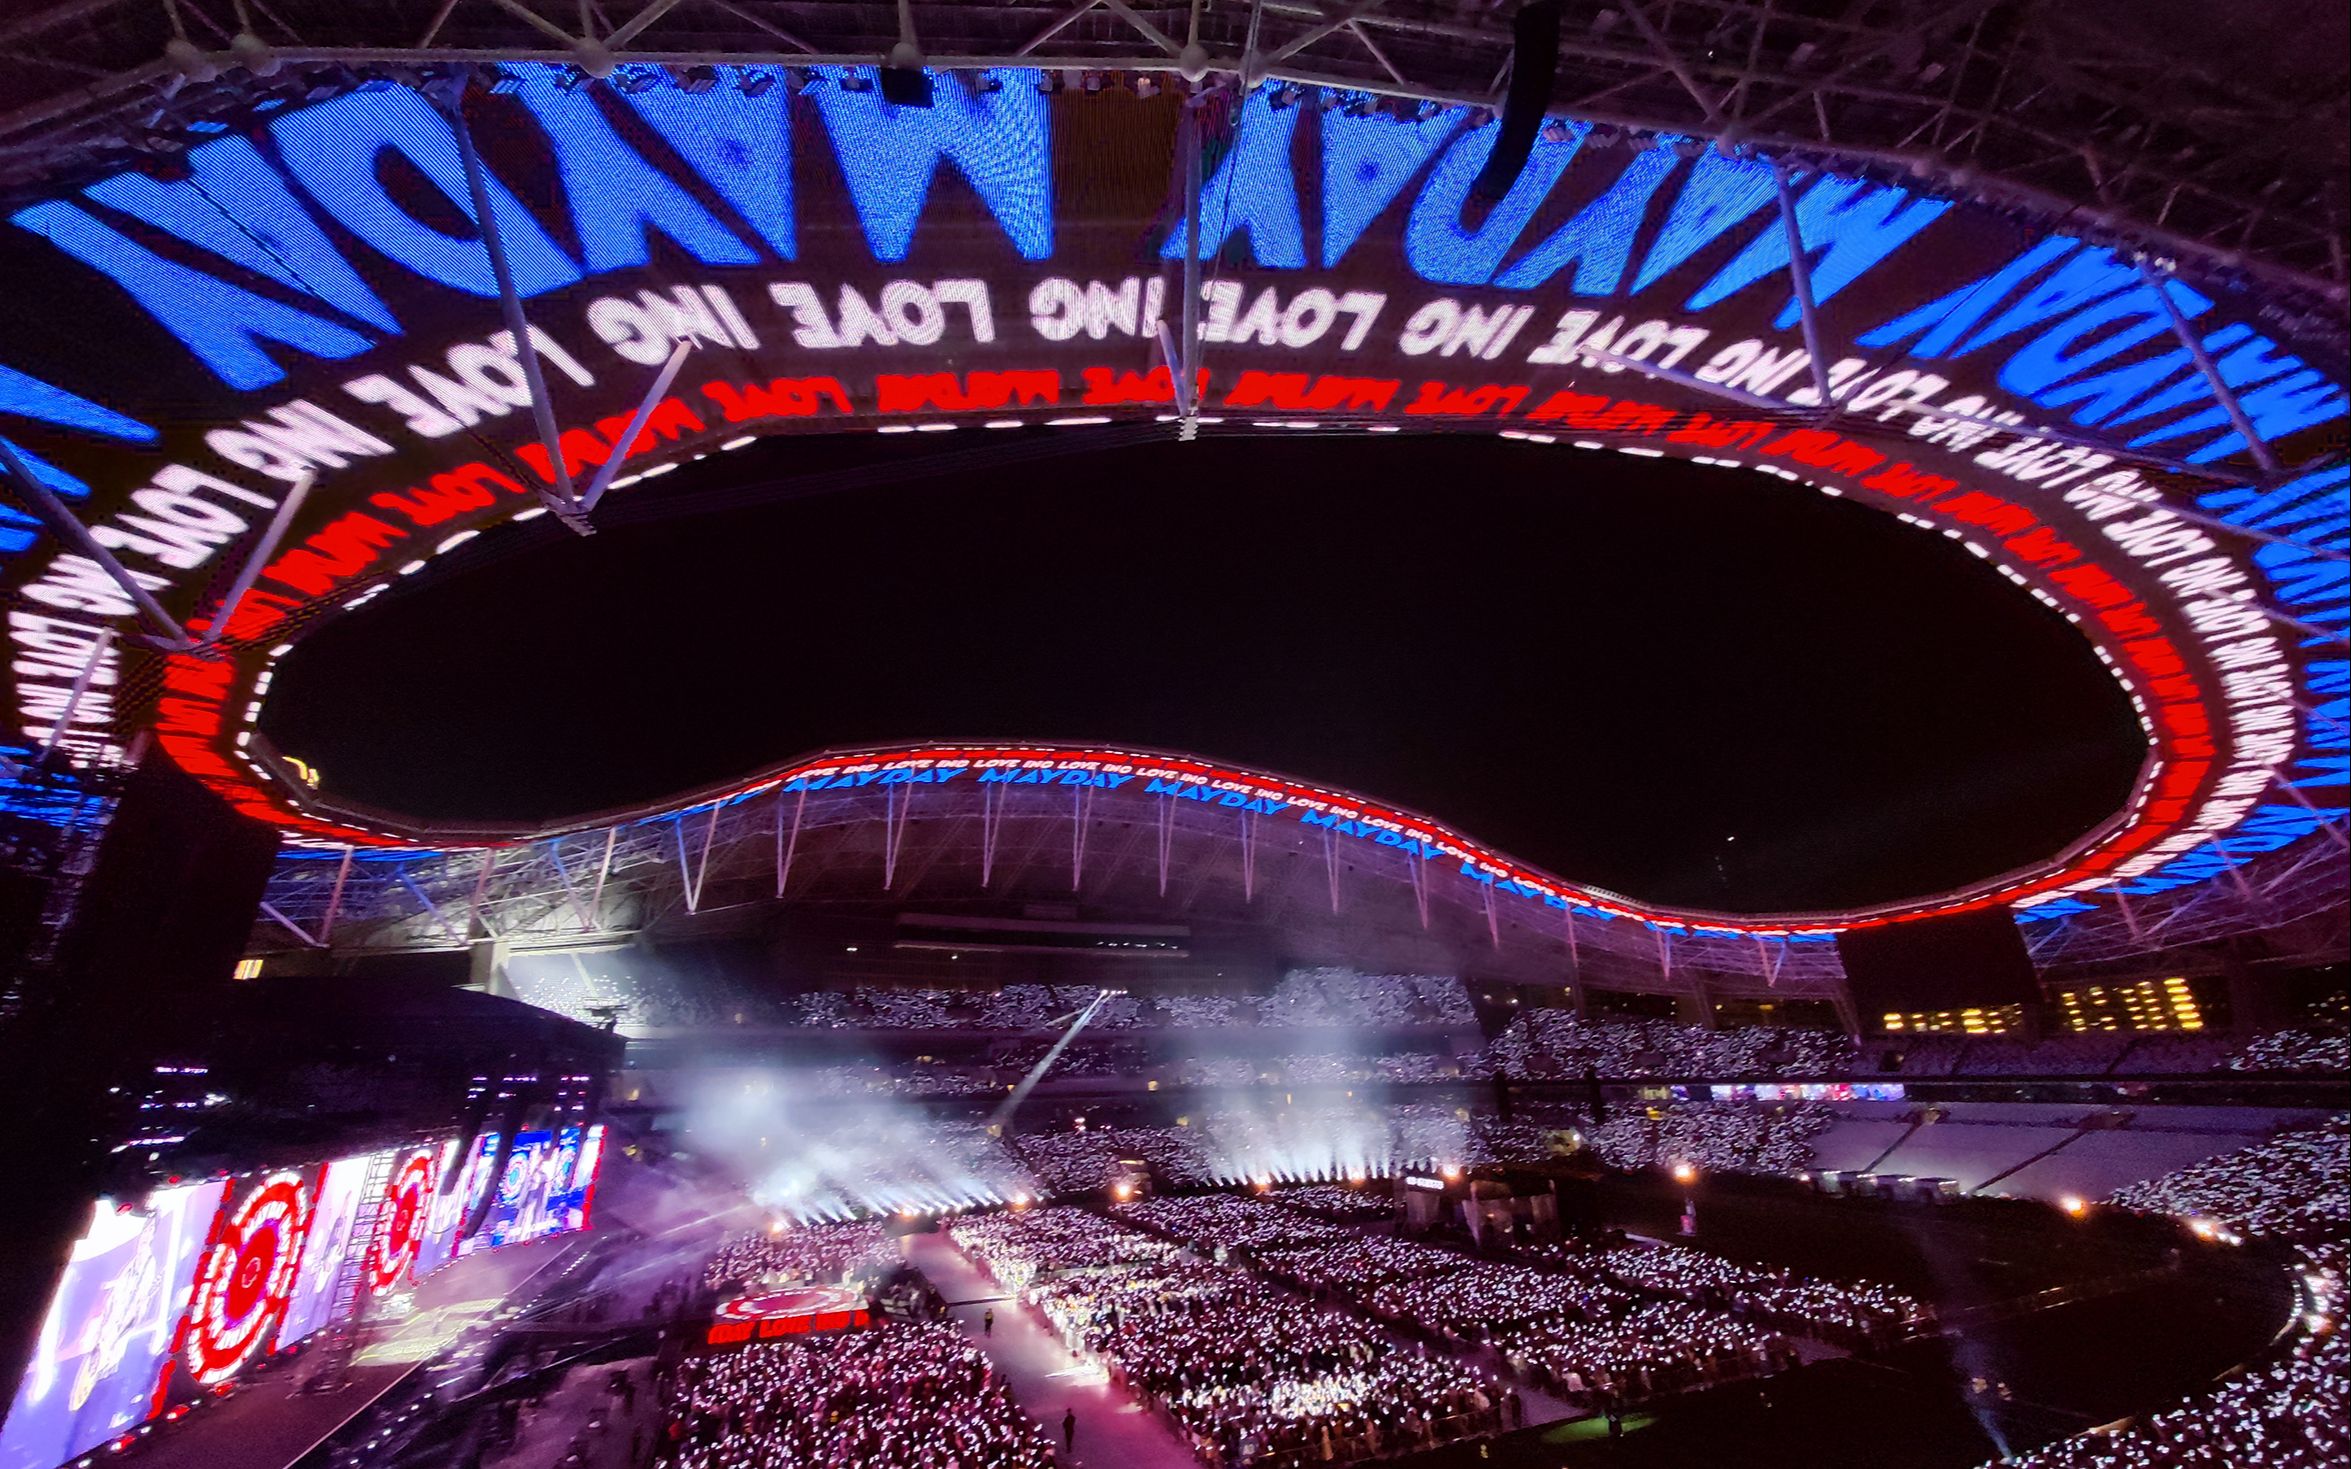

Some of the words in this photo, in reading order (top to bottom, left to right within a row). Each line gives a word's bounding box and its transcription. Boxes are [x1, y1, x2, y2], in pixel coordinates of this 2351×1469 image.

[6, 61, 1055, 392] MAYDAY
[1160, 78, 1956, 332] MAYDAY
[587, 284, 760, 366] ING
[768, 278, 994, 348] LOVE
[1029, 277, 1165, 341] ING
[1196, 280, 1386, 351] LOVE
[1399, 299, 1535, 360] ING
[1526, 310, 1708, 378] LOVE
[345, 324, 594, 422] LOVE
[1694, 339, 1809, 396] ING
[206, 398, 395, 482] ING
[783, 767, 967, 793] MAYDAY
[976, 767, 1136, 790] MAYDAY
[1144, 777, 1290, 816] MAYDAY
[1300, 808, 1446, 861] MAYDAY
[882, 760, 934, 770] LOVE
[936, 760, 970, 768] ING
[973, 760, 1021, 768] LOVE
[1022, 760, 1054, 768] ING
[1057, 761, 1100, 770] LOVE
[1102, 764, 1132, 774] ING
[1136, 768, 1178, 779] LOVE
[1180, 773, 1208, 784] ING
[1212, 780, 1253, 794] LOVE
[1255, 788, 1283, 800] ING
[1286, 796, 1328, 810] LOVE
[1330, 806, 1358, 818] ING
[1361, 816, 1404, 832] LOVE
[1405, 828, 1432, 842] ING
[1436, 842, 1477, 864] LOVE
